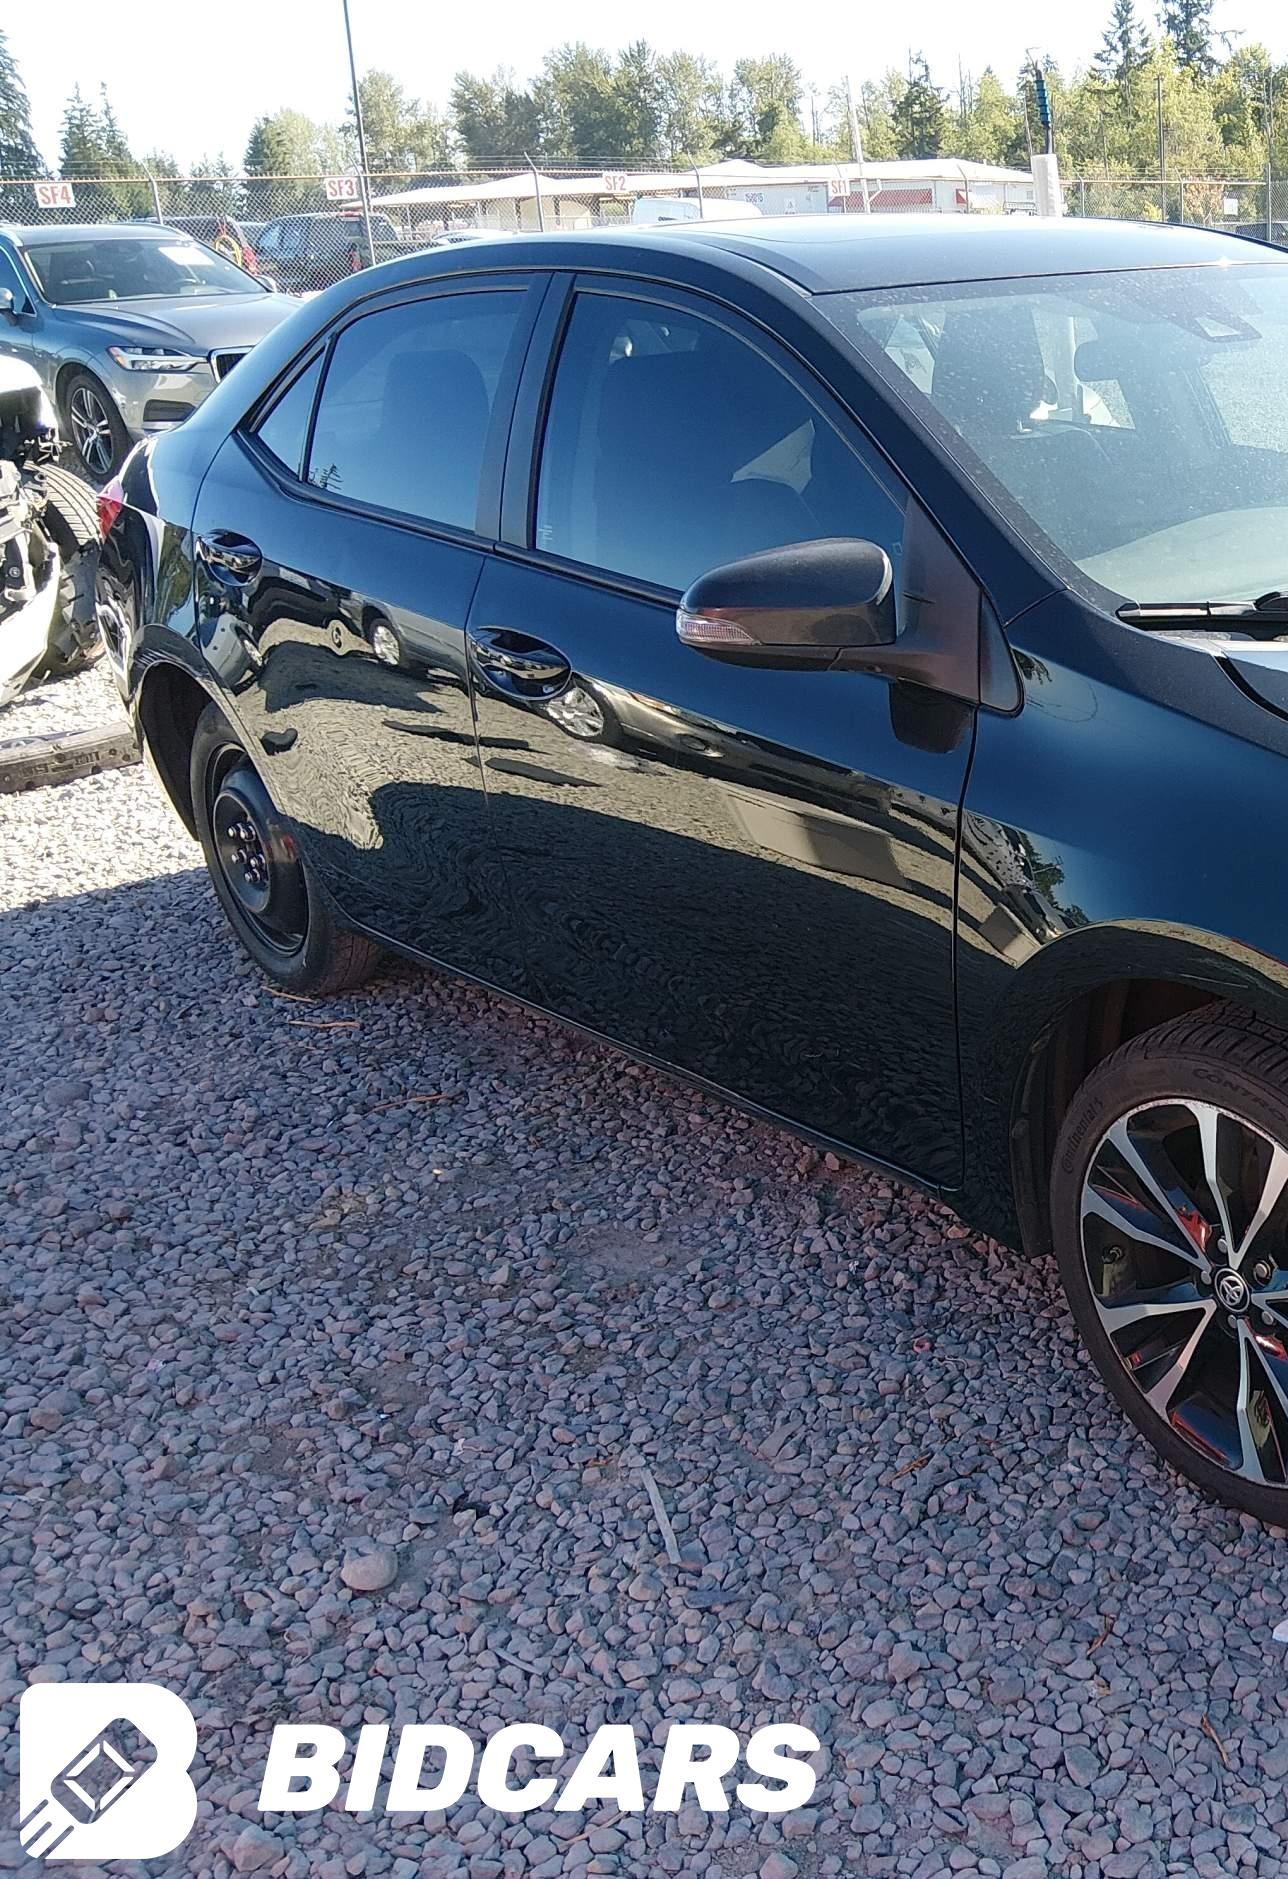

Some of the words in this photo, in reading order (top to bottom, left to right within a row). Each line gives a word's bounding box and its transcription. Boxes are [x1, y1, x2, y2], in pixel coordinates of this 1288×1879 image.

[328, 179, 354, 197] SF3
[605, 175, 627, 191] SF2
[831, 179, 847, 194] SF1
[39, 185, 71, 205] SF4
